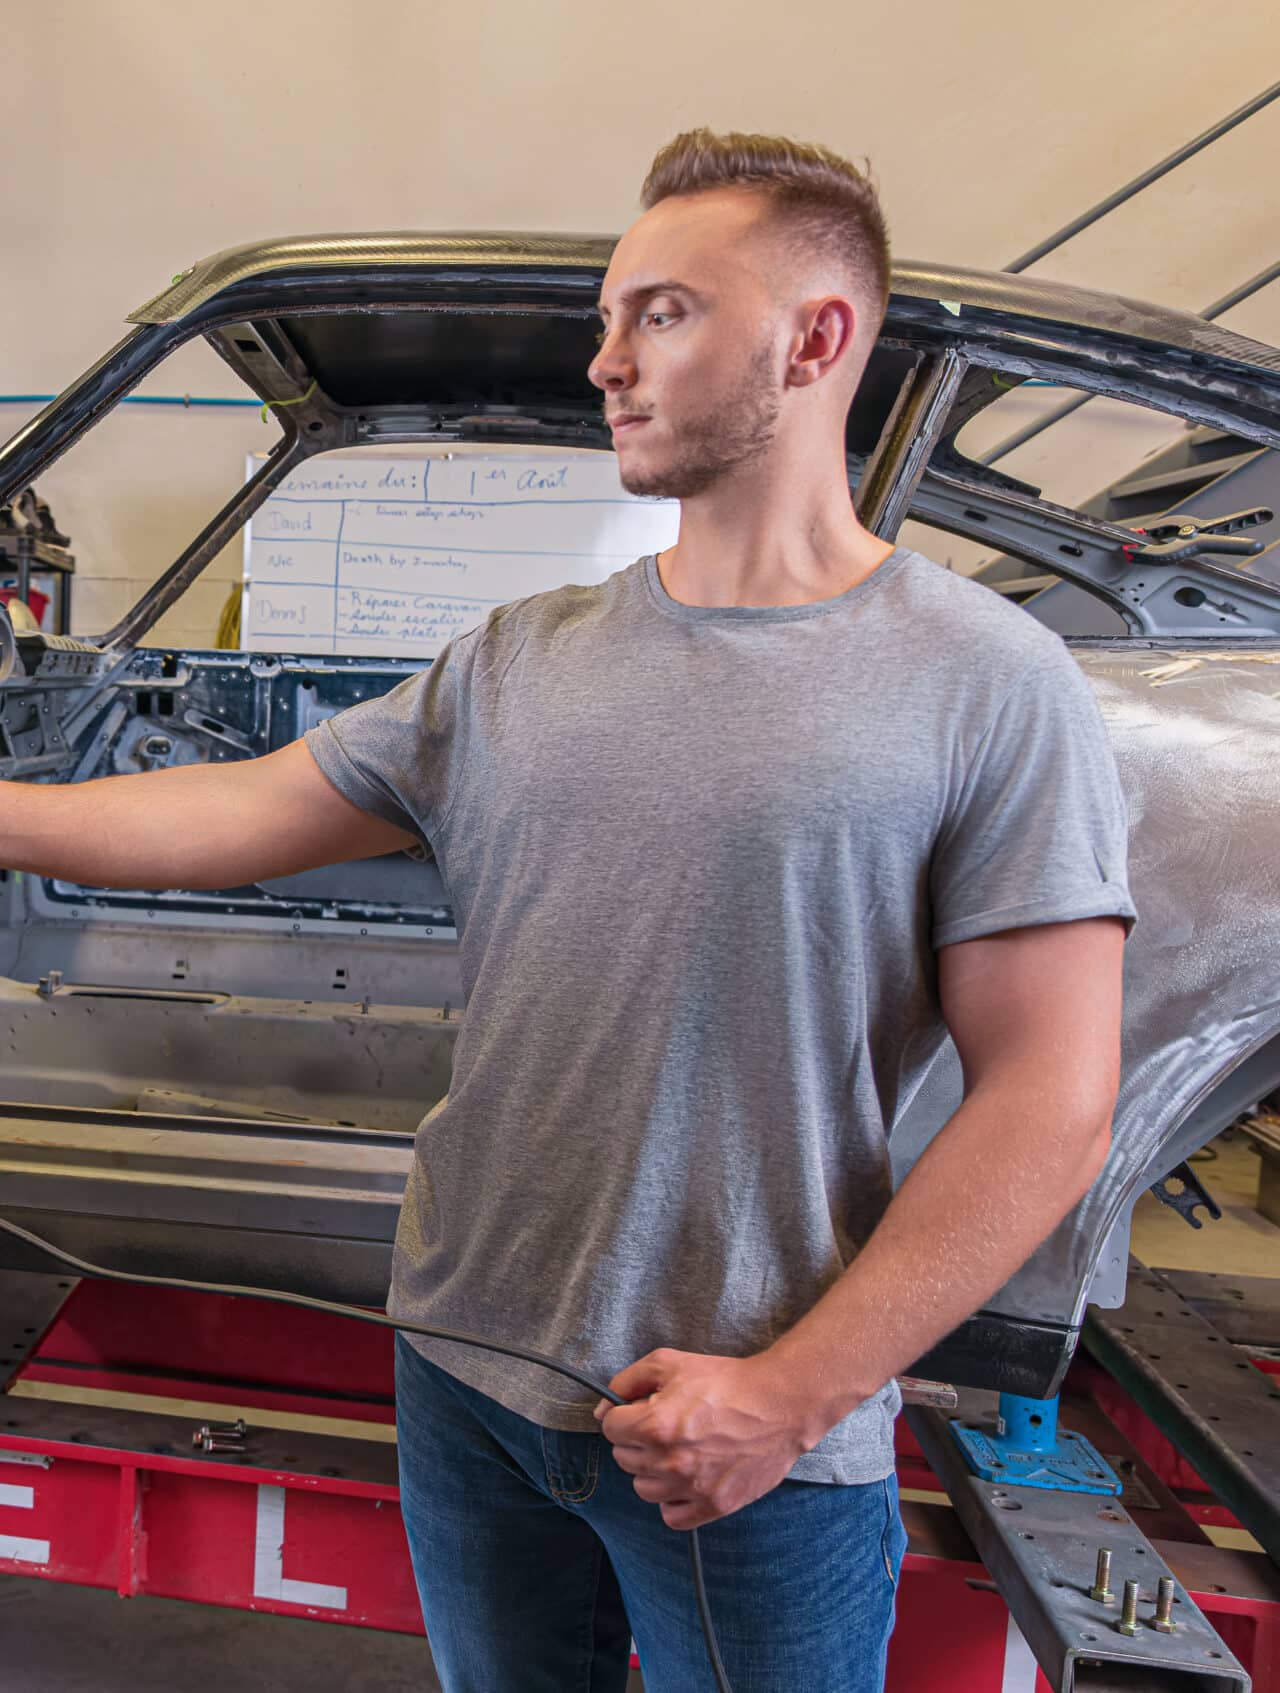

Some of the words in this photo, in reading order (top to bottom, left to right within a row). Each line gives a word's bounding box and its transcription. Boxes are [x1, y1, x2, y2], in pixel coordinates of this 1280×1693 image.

[277, 473, 368, 491] emaine
[343, 551, 382, 565] Death
[389, 554, 407, 568] by
[253, 1483, 348, 1610] L
